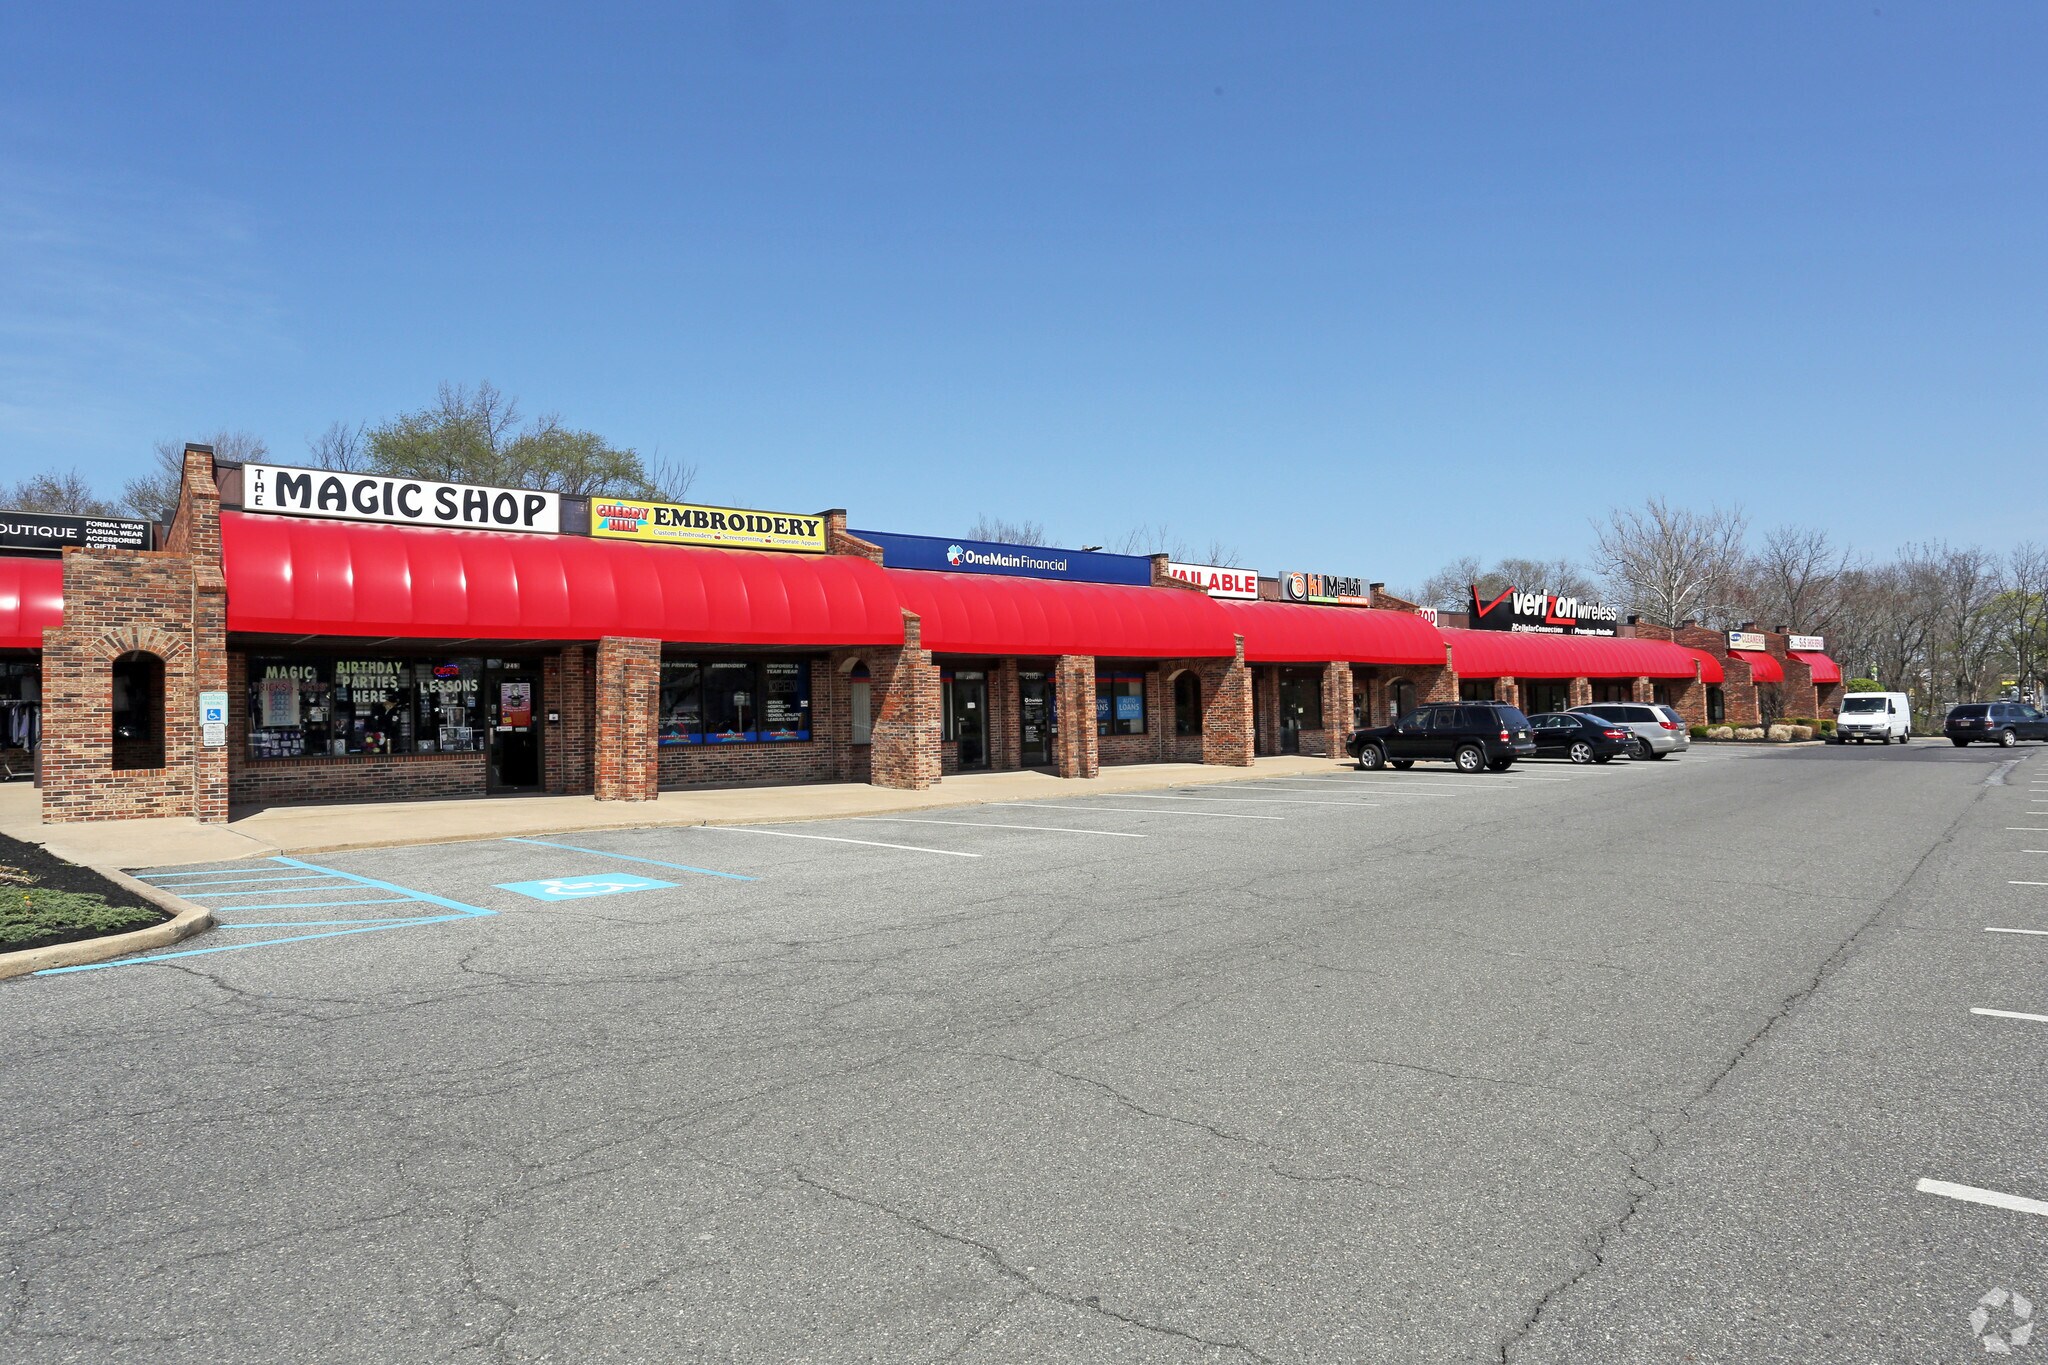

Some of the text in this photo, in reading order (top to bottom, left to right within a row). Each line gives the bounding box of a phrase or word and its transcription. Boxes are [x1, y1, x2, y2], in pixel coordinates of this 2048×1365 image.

[254, 469, 547, 527] THE MAGIC SHOP
[596, 504, 650, 533] CHERRY HILL
[653, 506, 819, 538] EMBROIDERY
[86, 520, 144, 531] FORMAL WEAR
[86, 528, 143, 538] CASUAL WEAR
[653, 529, 677, 538] Custom
[678, 531, 713, 540] Embroidery
[722, 534, 764, 544] Screenprinting
[772, 538, 799, 546] Corporate
[85, 535, 142, 545] ACCESSORIES
[965, 550, 1067, 571] OneMain Financial
[1326, 575, 1361, 597] Maki
[1512, 588, 1617, 625] verizon wireless
[266, 666, 313, 679] MAGIC
[337, 661, 402, 674] BIRTHDAY
[342, 675, 398, 688] PARTIES
[420, 680, 478, 693] LESSONS
[353, 690, 387, 703] HERE
